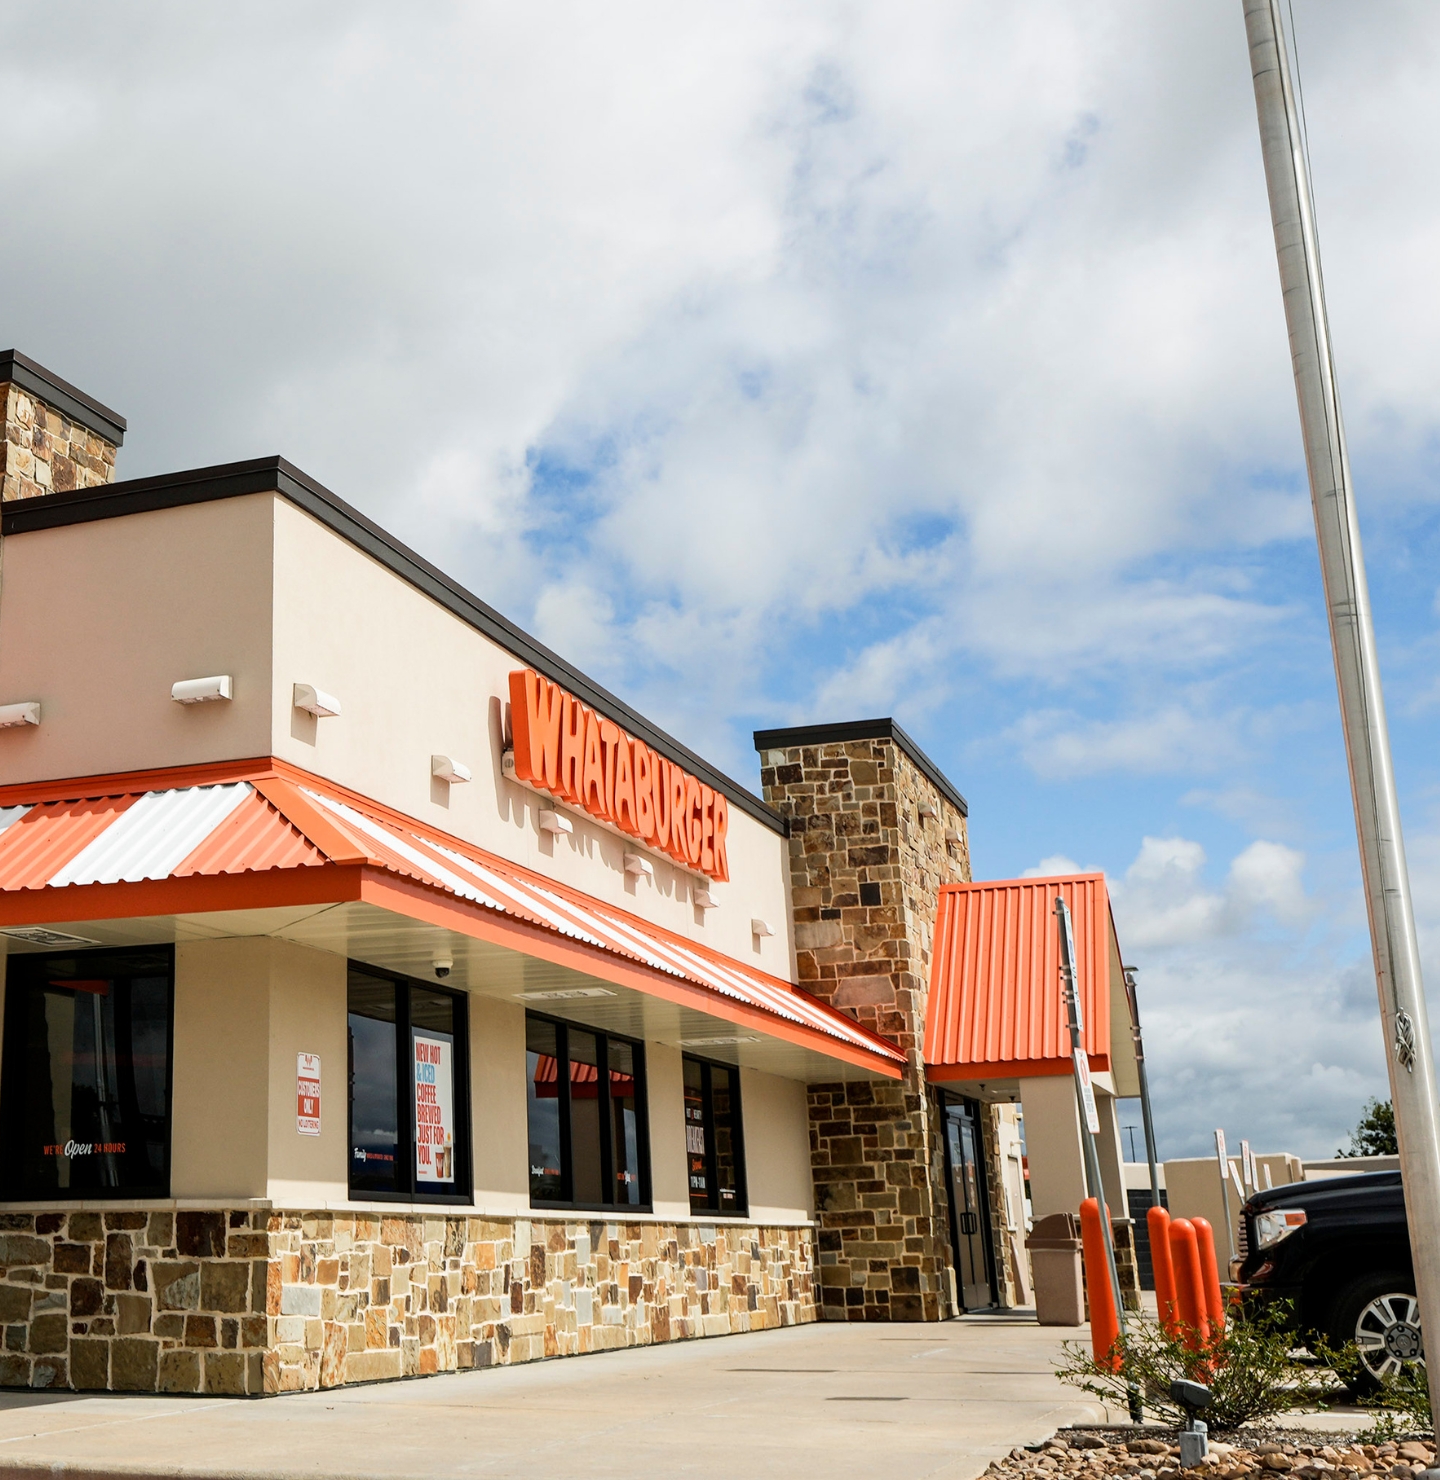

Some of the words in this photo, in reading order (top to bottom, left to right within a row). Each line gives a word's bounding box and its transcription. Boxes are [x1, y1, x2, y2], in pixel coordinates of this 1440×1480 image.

[509, 669, 730, 883] WHATABURGER
[416, 1042, 429, 1063] NEW
[430, 1044, 441, 1065] HOT
[416, 1062, 422, 1081] &
[422, 1063, 435, 1084] ICED
[298, 1080, 320, 1098] CUSTOMERS
[417, 1083, 436, 1104] COFFEE
[303, 1098, 314, 1114] ONLY
[417, 1104, 442, 1125] BREWED
[417, 1124, 433, 1145] JUST
[433, 1126, 445, 1146] FOR
[43, 1144, 64, 1155] WE'RE
[64, 1139, 92, 1160] Open
[93, 1143, 102, 1154] 24
[103, 1142, 126, 1154] HOURS
[417, 1145, 432, 1165] YOU.
